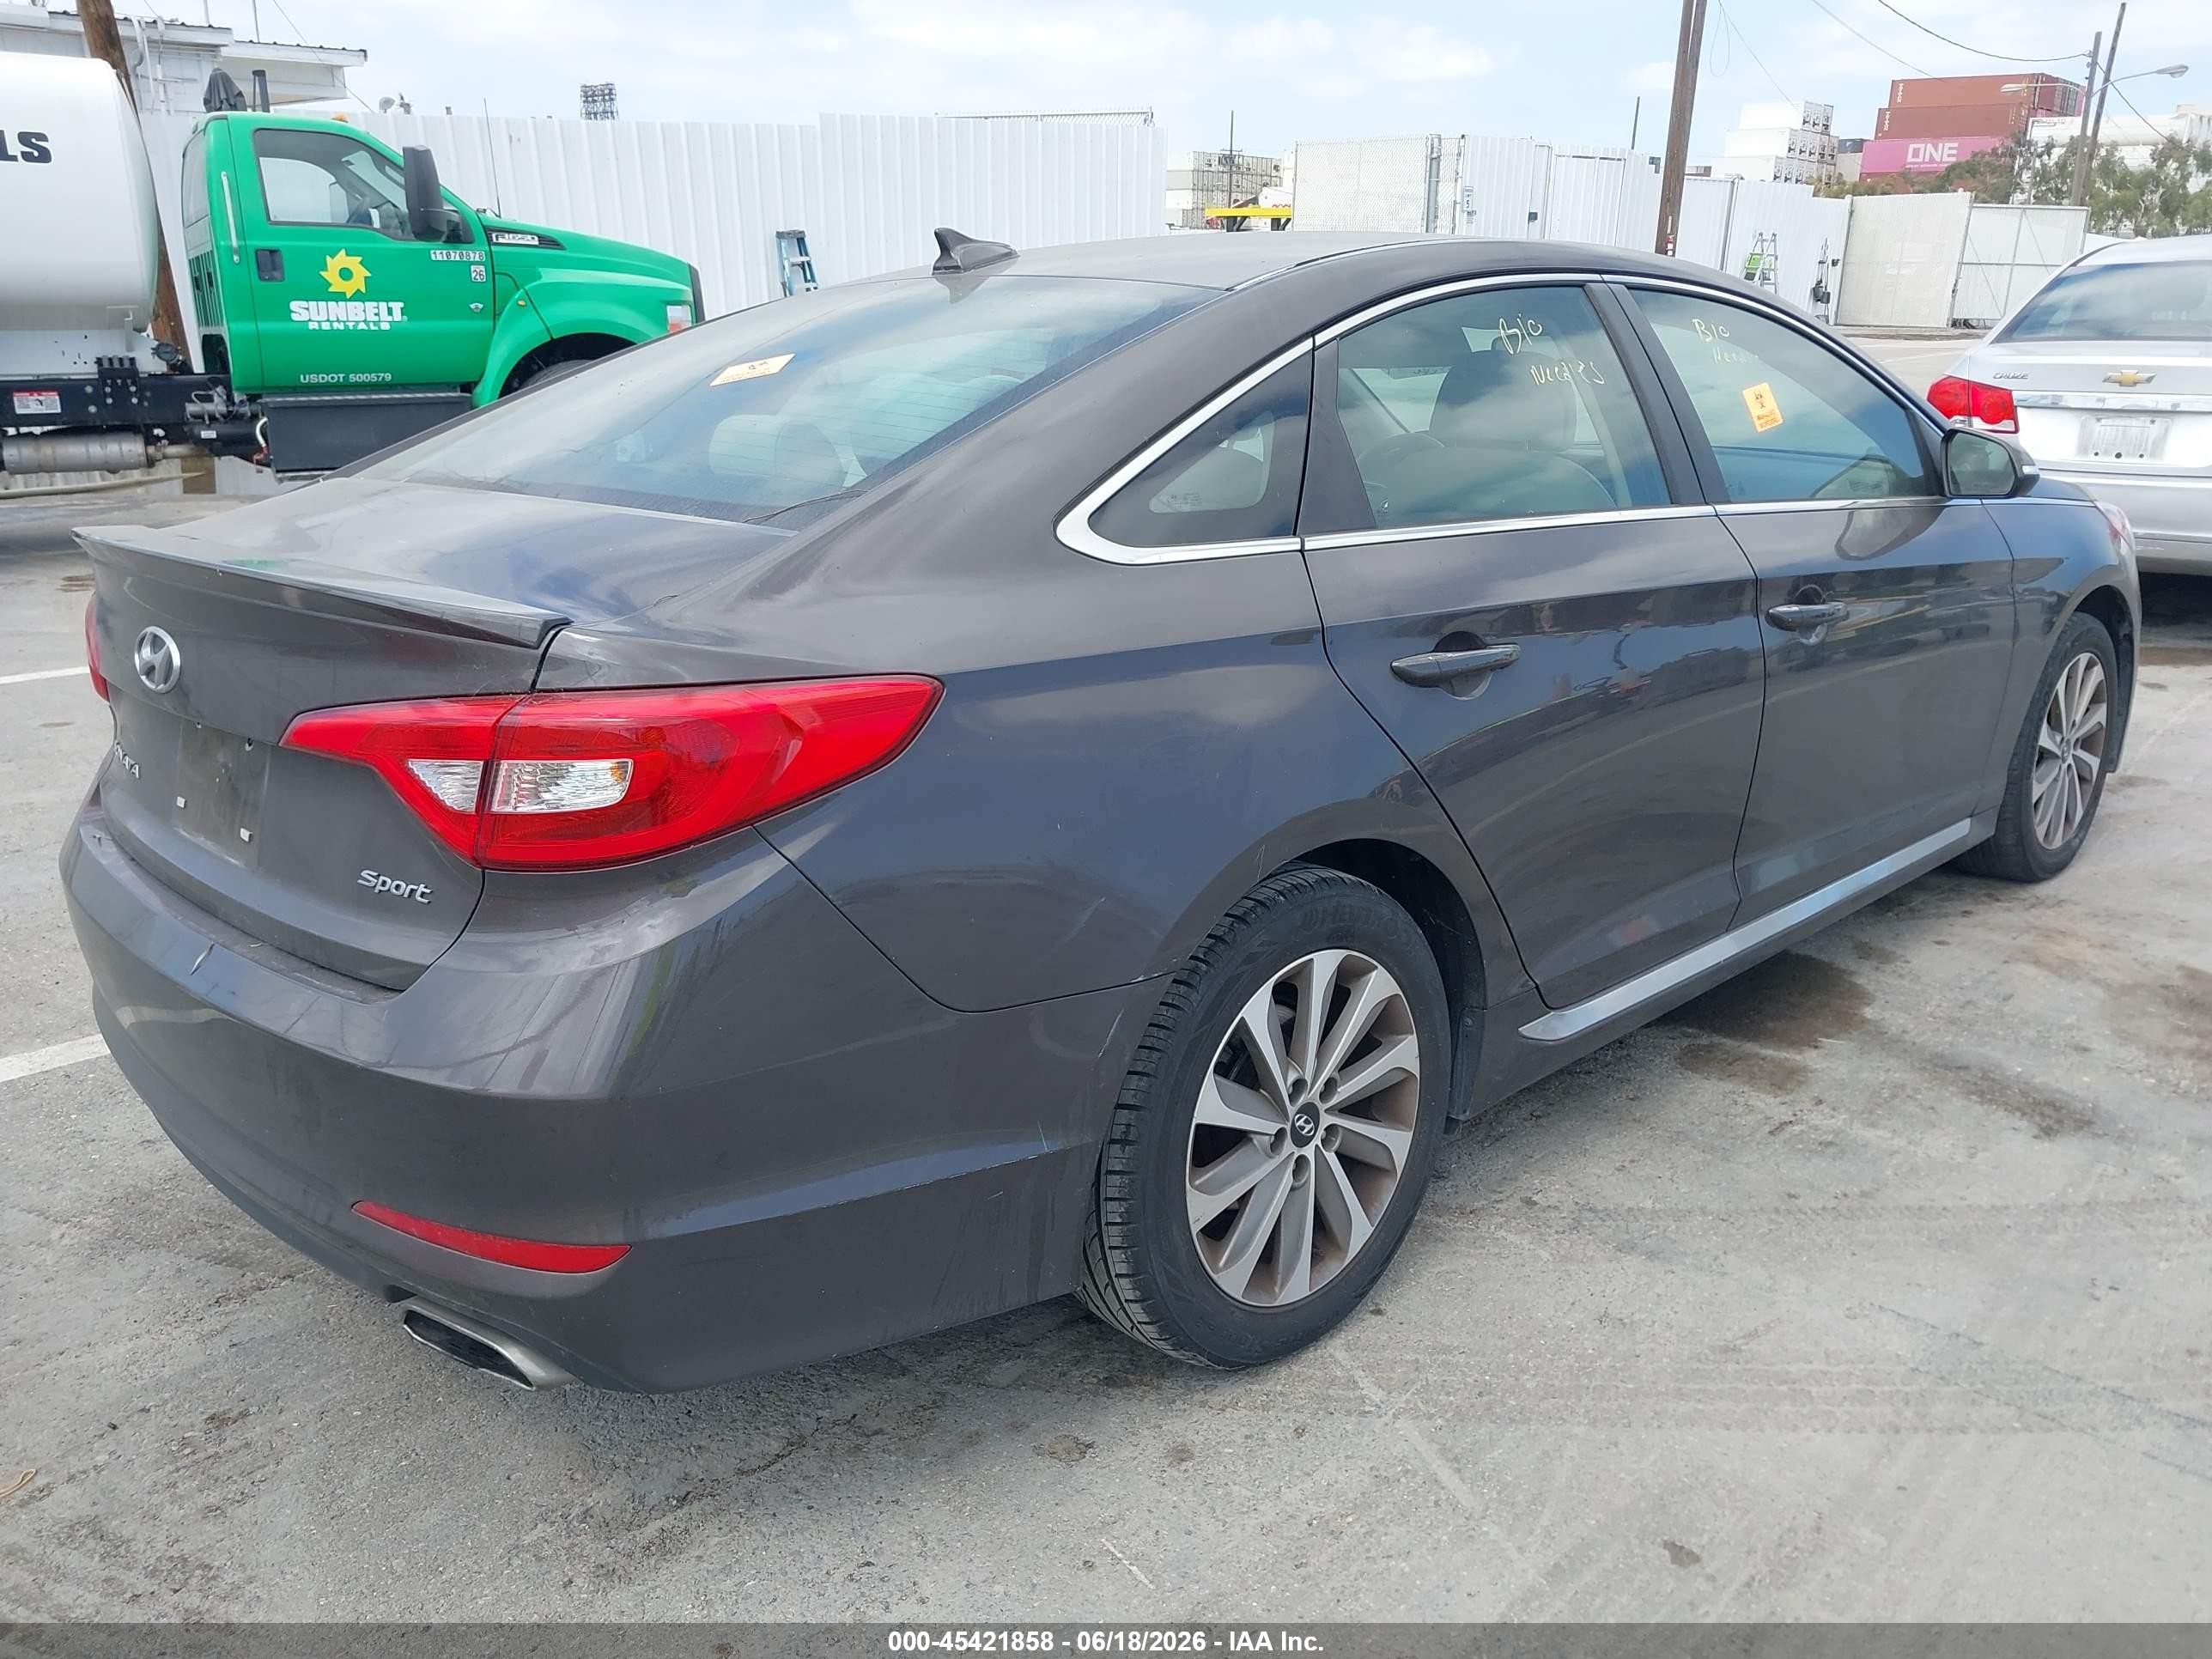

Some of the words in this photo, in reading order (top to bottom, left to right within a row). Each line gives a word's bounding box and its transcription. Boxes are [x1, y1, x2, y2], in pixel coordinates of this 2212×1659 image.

[1906, 142, 1959, 162] ONE
[432, 251, 485, 261] 11070878
[472, 270, 485, 281] 26
[289, 301, 404, 321] SUNBELT
[308, 321, 391, 330] RENTALS
[300, 374, 345, 383] USDOT
[349, 373, 392, 382] 500579
[1992, 371, 2029, 380] CRUZE
[356, 869, 434, 904] Sport
